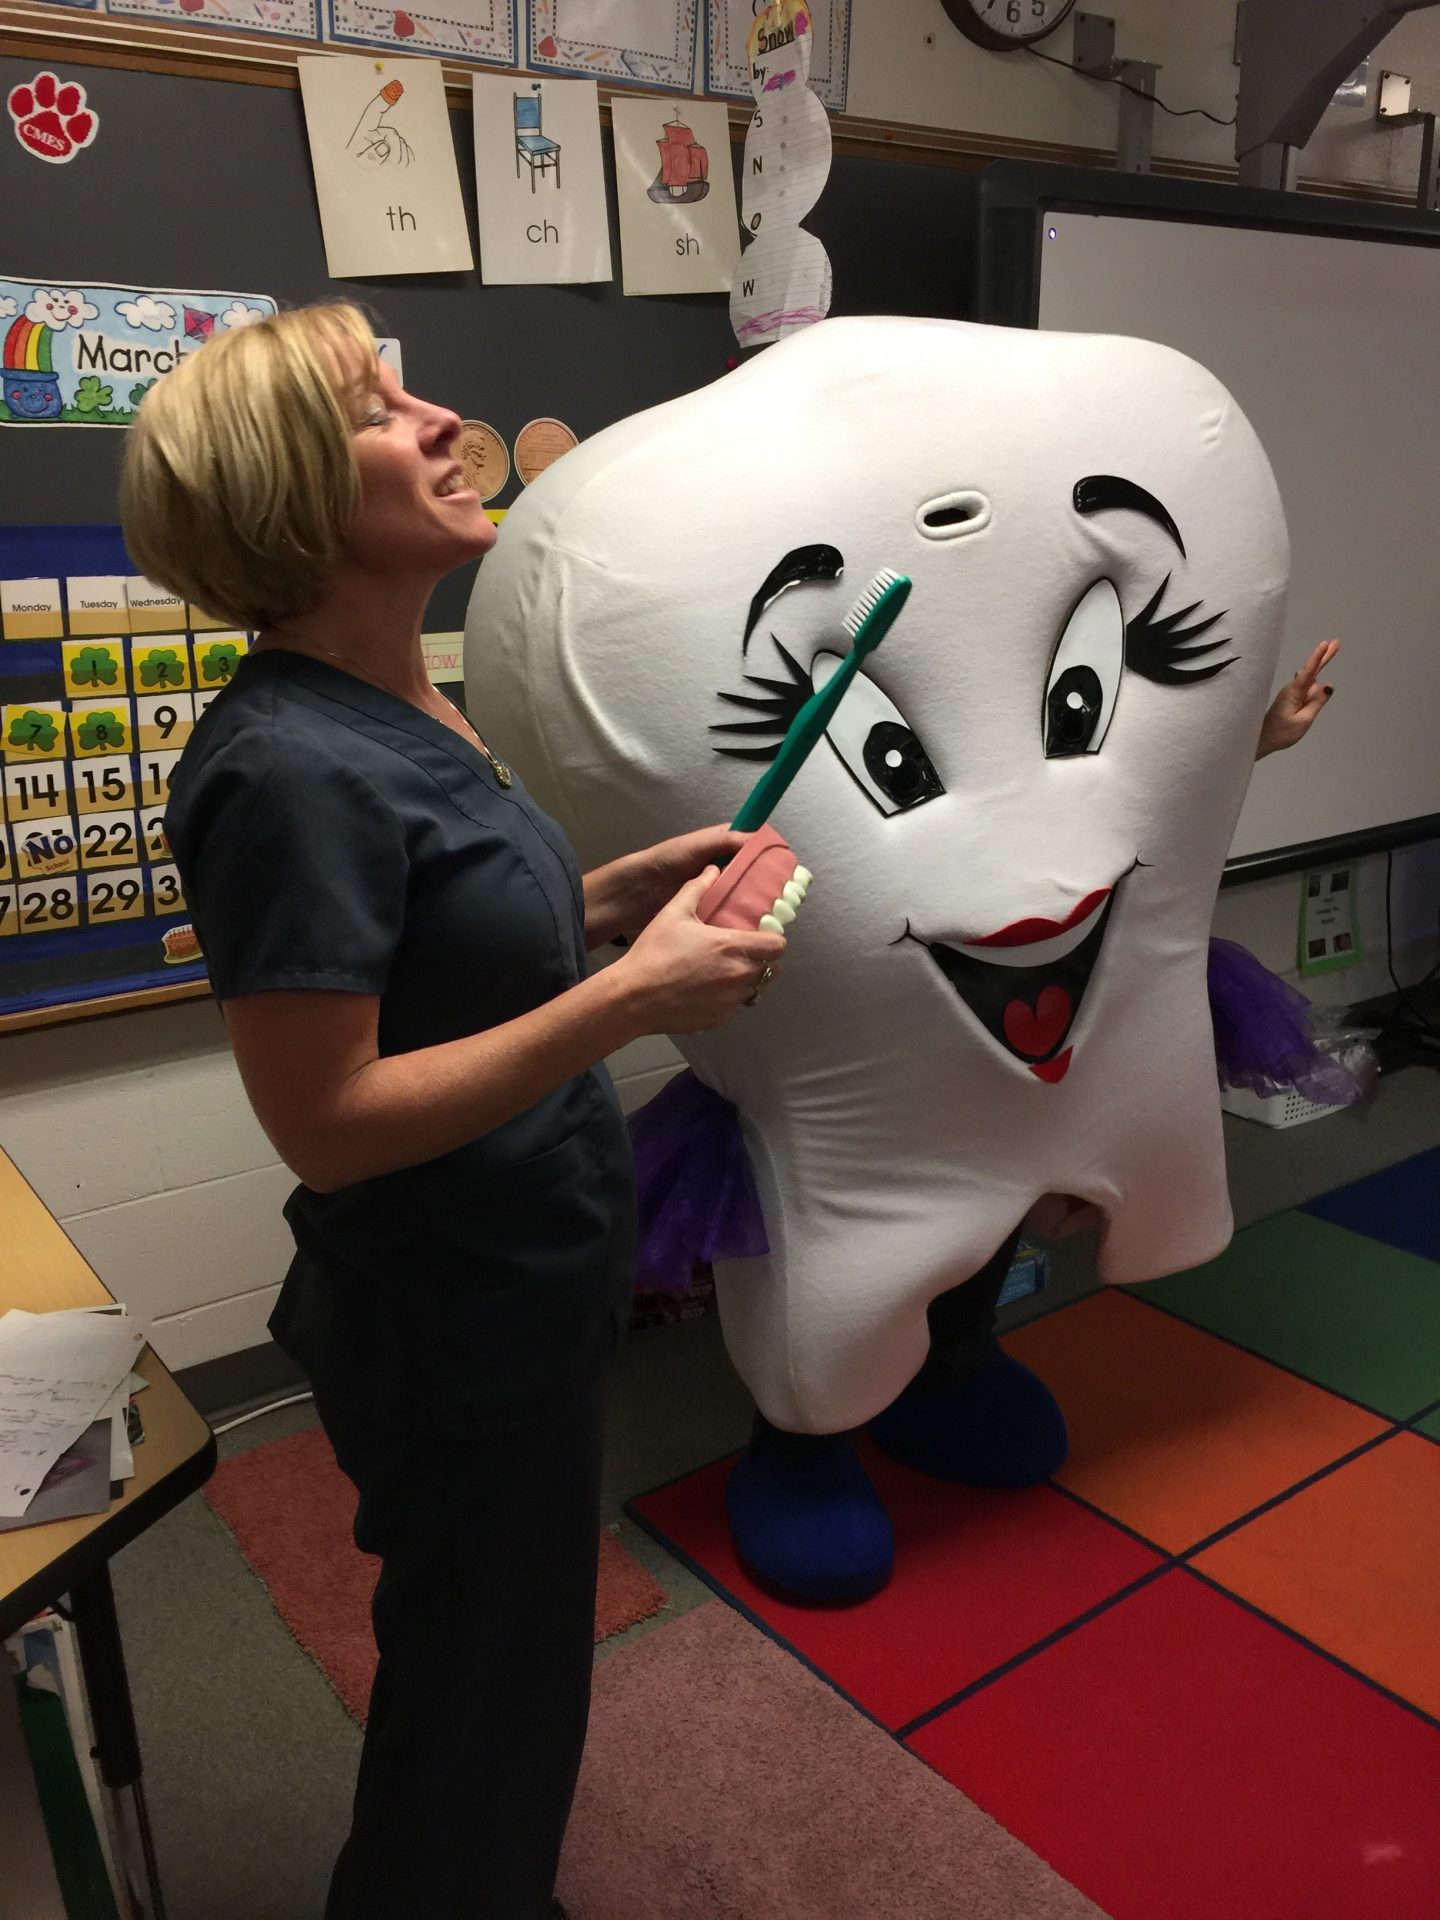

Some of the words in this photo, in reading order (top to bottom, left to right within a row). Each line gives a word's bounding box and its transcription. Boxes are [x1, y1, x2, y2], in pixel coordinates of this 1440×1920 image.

[1006, 0, 1021, 23] 6
[757, 21, 795, 52] Snow
[752, 62, 769, 85] by:
[753, 109, 763, 128] S
[23, 124, 66, 151] CMES
[753, 156, 763, 175] N
[386, 206, 417, 231] th
[526, 219, 559, 243] ch
[675, 233, 701, 256] sh
[742, 279, 755, 297] W
[12, 603, 52, 612] Monday
[80, 600, 118, 609] Tuesday
[130, 597, 181, 607] Wednesday
[91, 660, 98, 677] 1
[156, 661, 168, 678] 2
[218, 656, 230, 673] 3
[30, 723, 42, 740] 7
[95, 724, 108, 741] 8
[154, 705, 177, 740] 9
[14, 773, 59, 810] 14
[82, 767, 126, 803] 15
[148, 761, 180, 795] 1
[25, 835, 74, 865] No
[84, 822, 133, 858] 22
[44, 858, 70, 872] School
[23, 888, 74, 924] 28
[91, 879, 140, 915] 29
